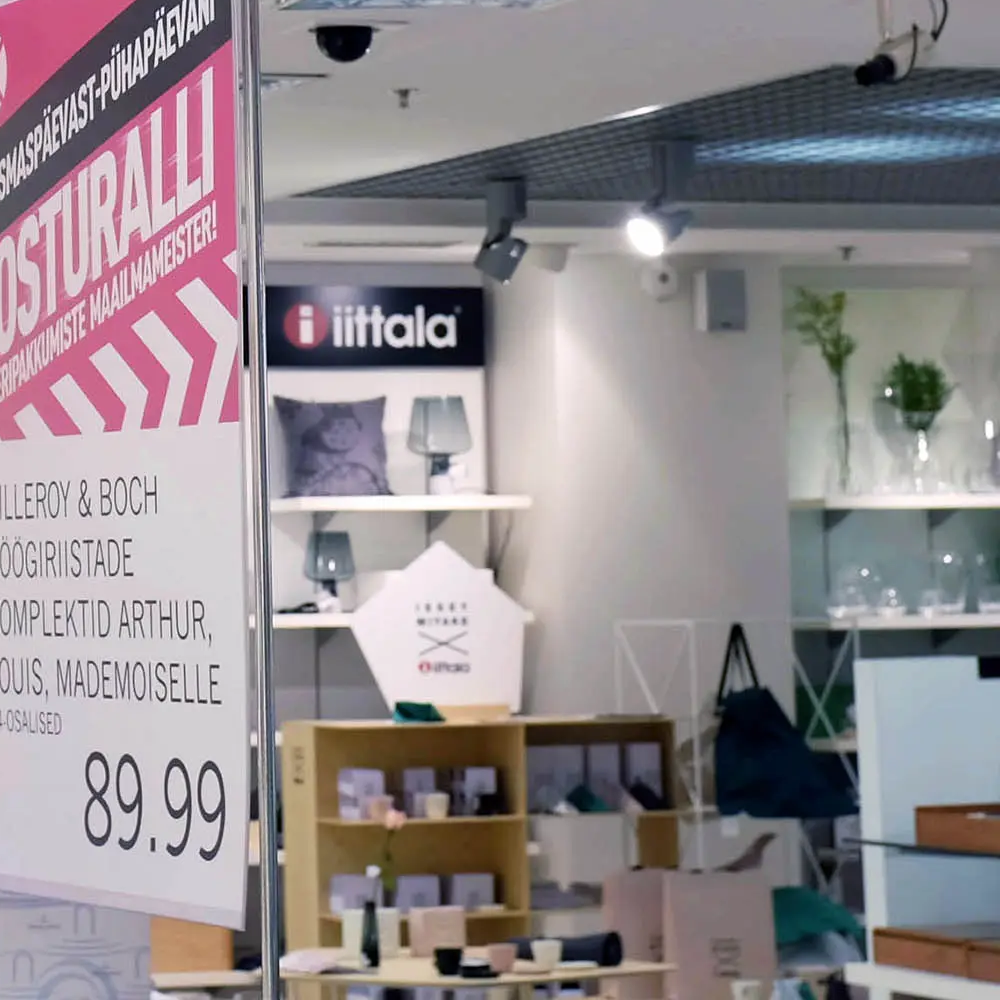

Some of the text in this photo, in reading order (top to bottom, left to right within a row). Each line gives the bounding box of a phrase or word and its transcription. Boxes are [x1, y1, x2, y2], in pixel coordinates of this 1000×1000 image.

[90, 200, 217, 326] MAAILMAMEISTER!
[332, 304, 457, 348] iittala
[78, 479, 93, 518] &
[100, 475, 158, 516] BOCH
[119, 600, 213, 646] ARTHUR,
[56, 658, 222, 705] MADEMOISELLE
[84, 751, 226, 862] 89.99
